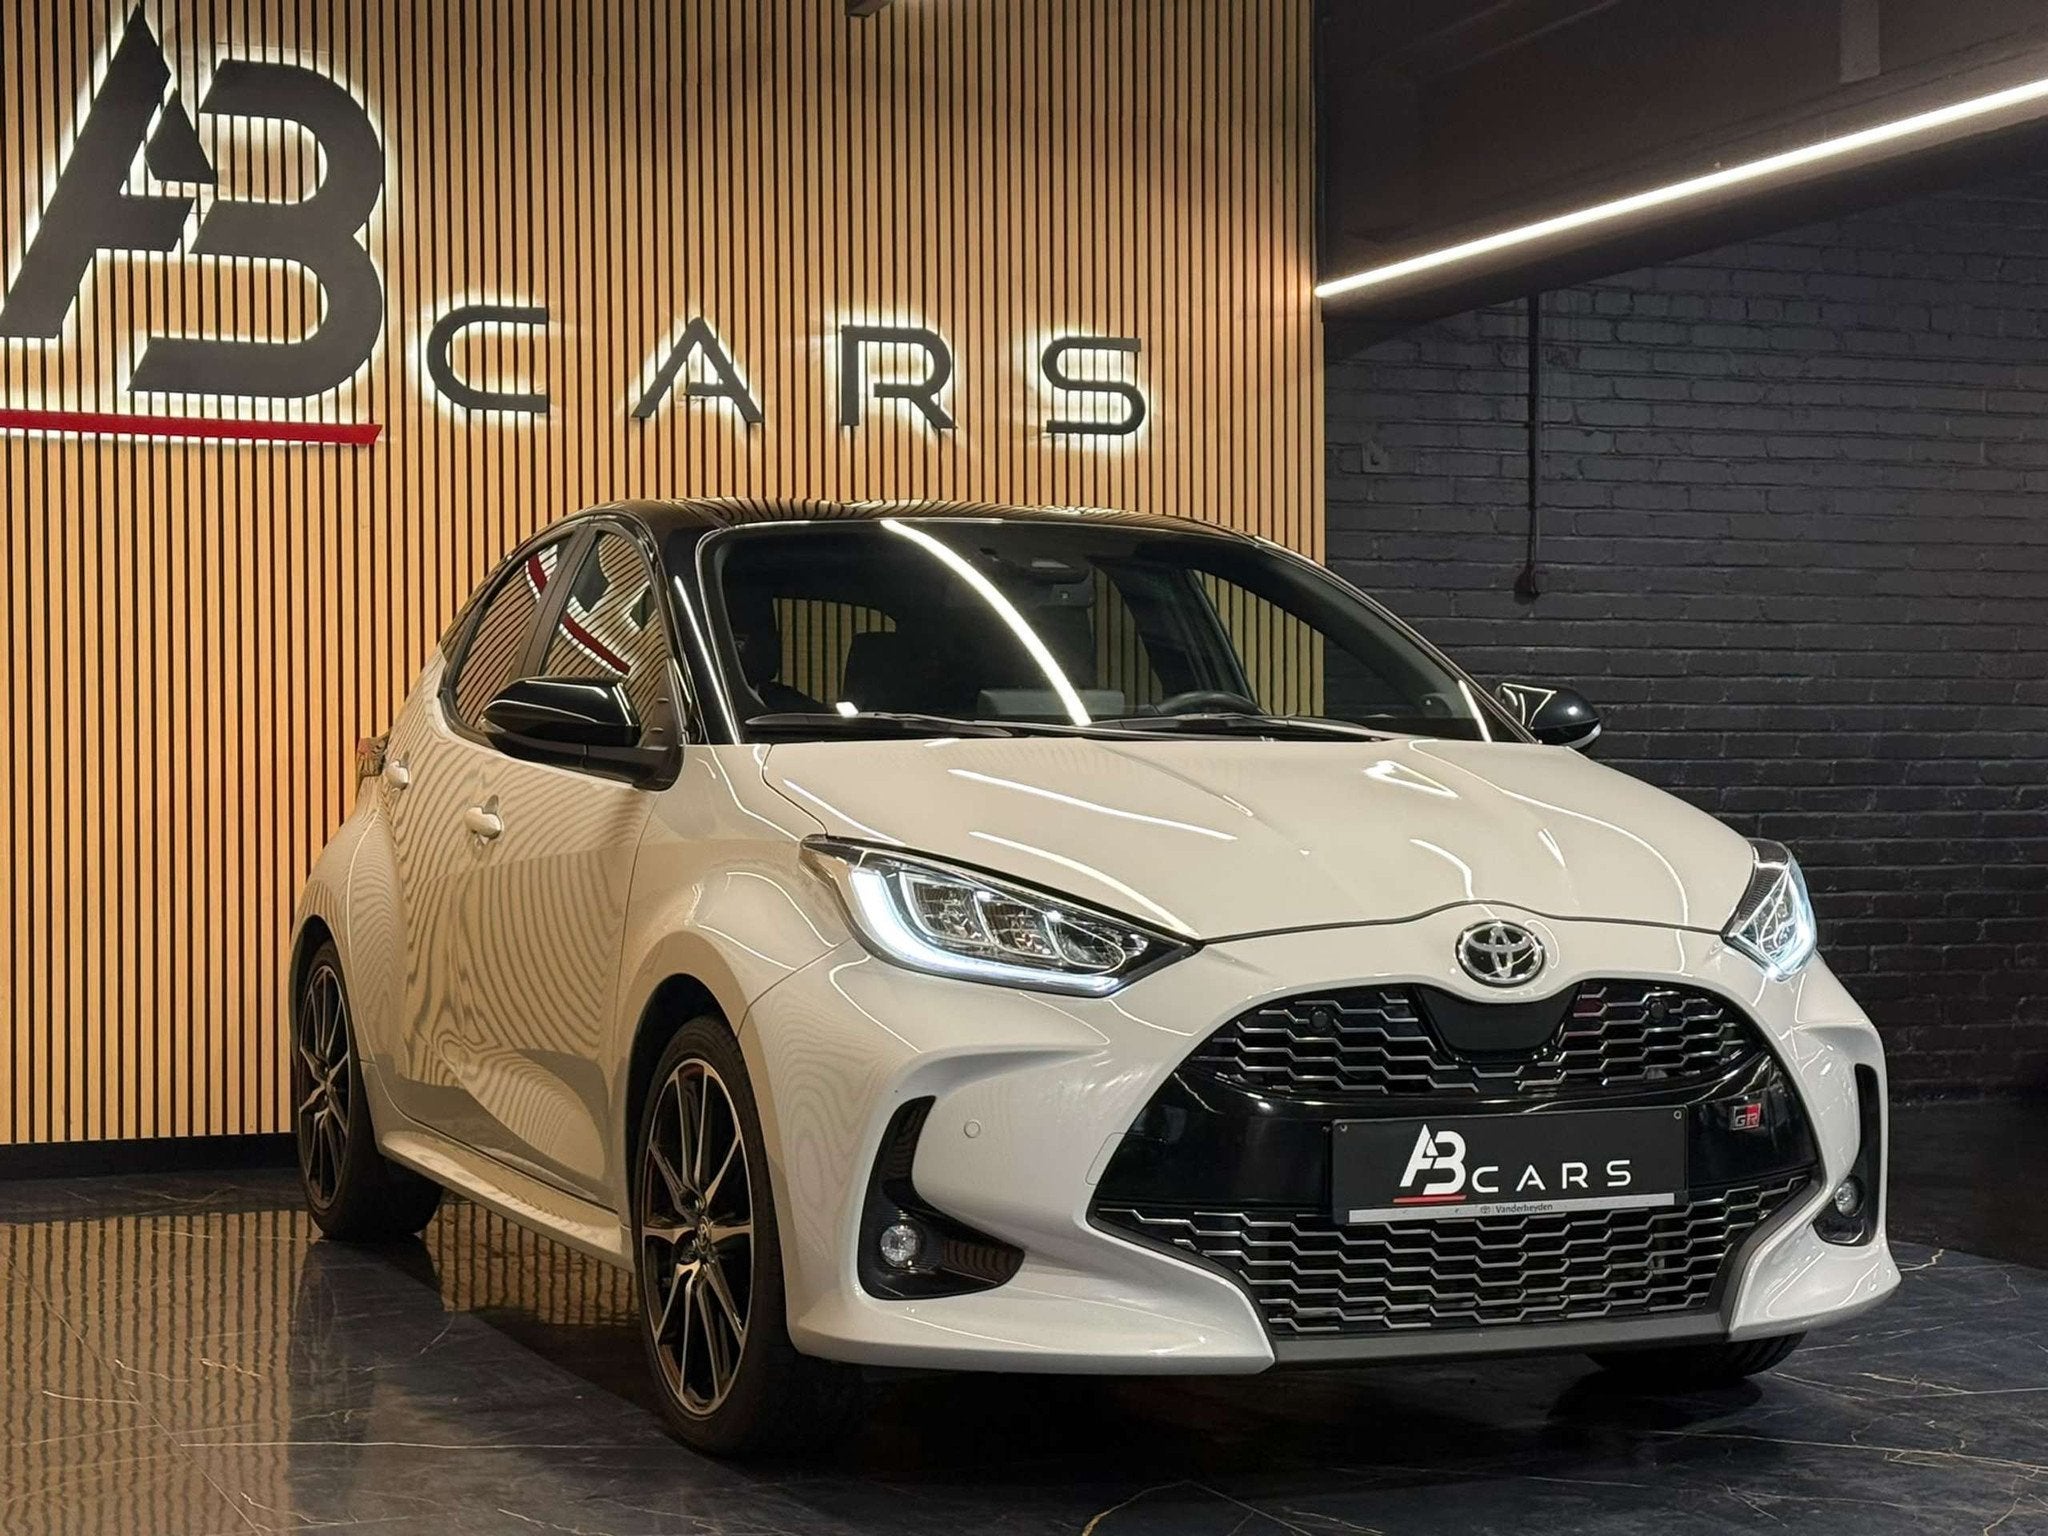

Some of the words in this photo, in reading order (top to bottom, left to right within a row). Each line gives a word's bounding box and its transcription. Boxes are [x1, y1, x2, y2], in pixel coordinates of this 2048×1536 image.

[0, 4, 383, 399] AB
[427, 304, 1146, 435] CARS
[1400, 1124, 1466, 1195] AB
[1472, 1160, 1631, 1193] CARS
[1495, 1203, 1553, 1214] Vanderheyden
